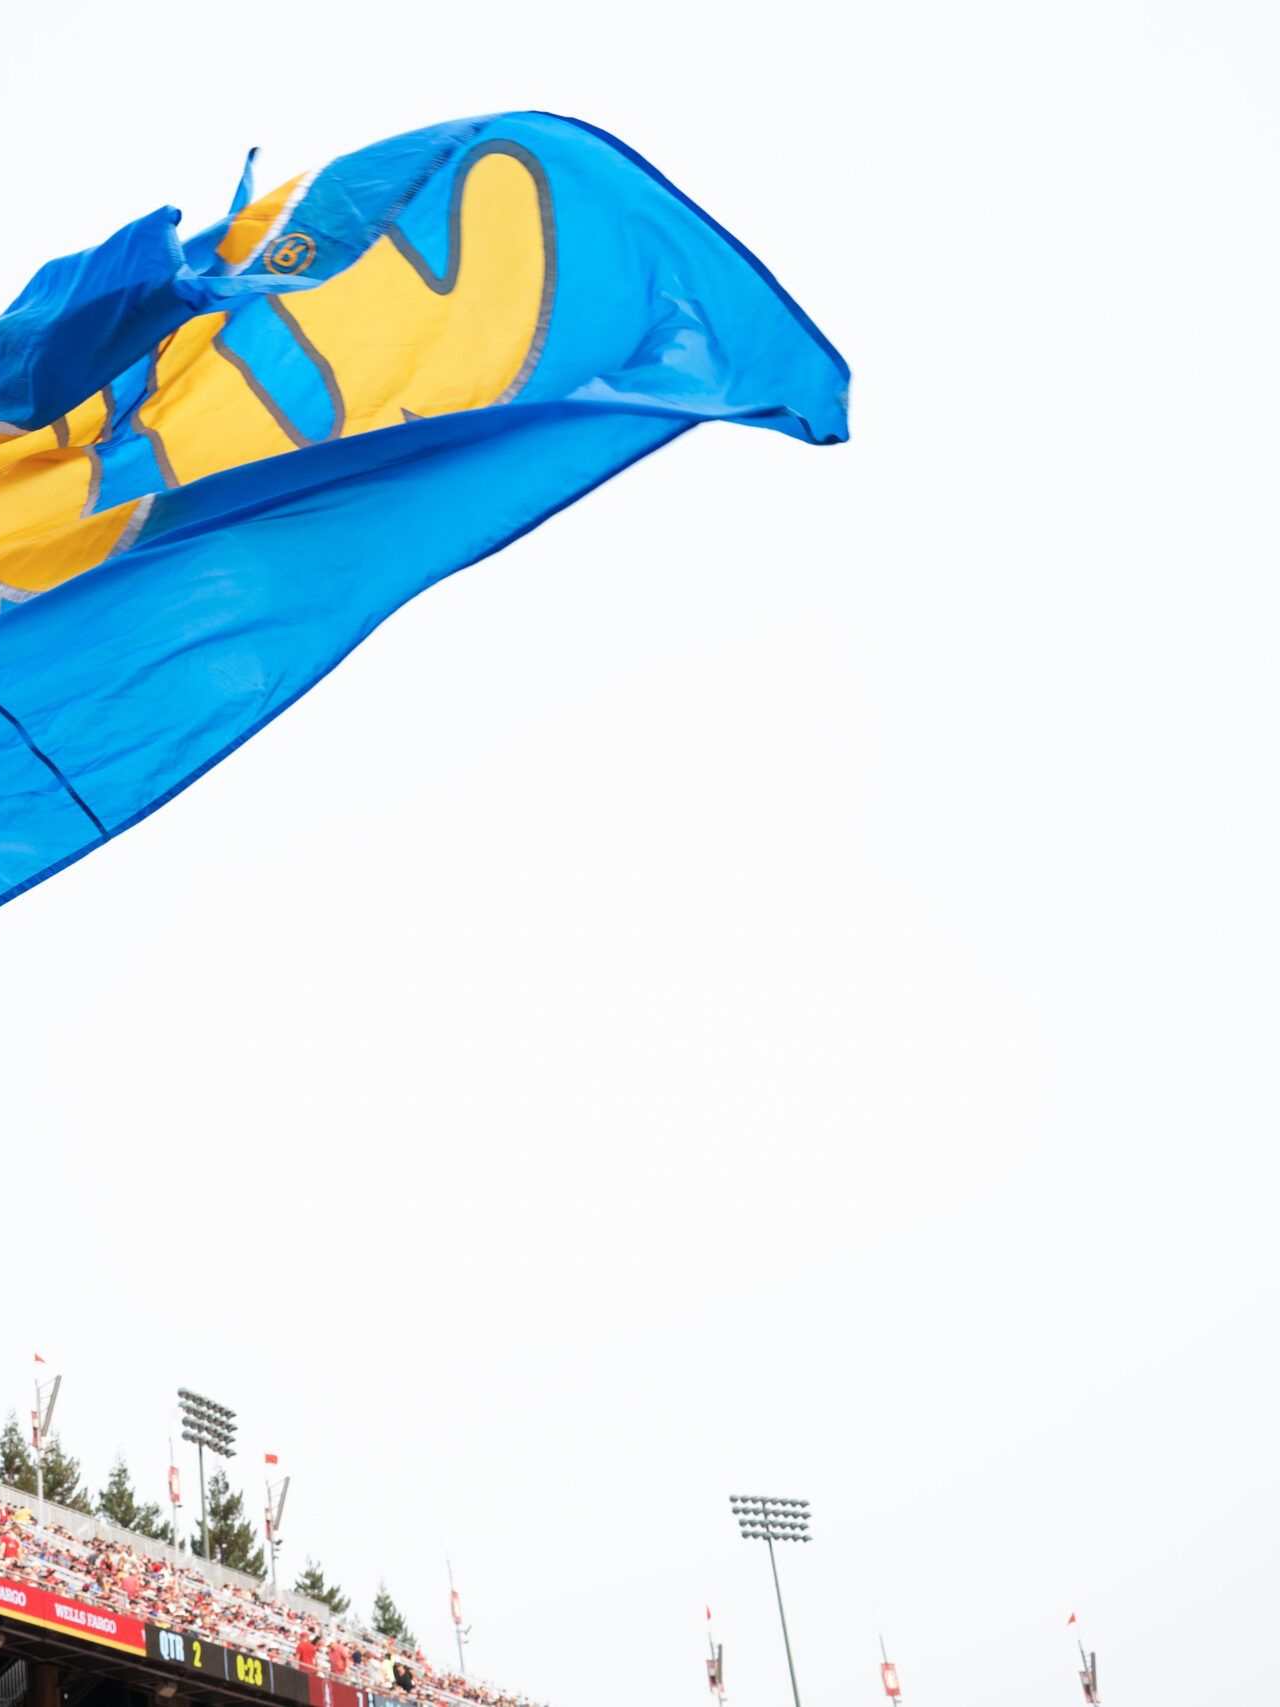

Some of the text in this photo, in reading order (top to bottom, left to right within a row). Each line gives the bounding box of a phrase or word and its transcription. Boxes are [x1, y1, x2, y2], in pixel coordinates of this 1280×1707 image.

[54, 1603, 117, 1634] WELLS FARGO
[158, 1630, 185, 1662] QTR
[192, 1640, 202, 1668] 2
[236, 1653, 263, 1686] 0:23
